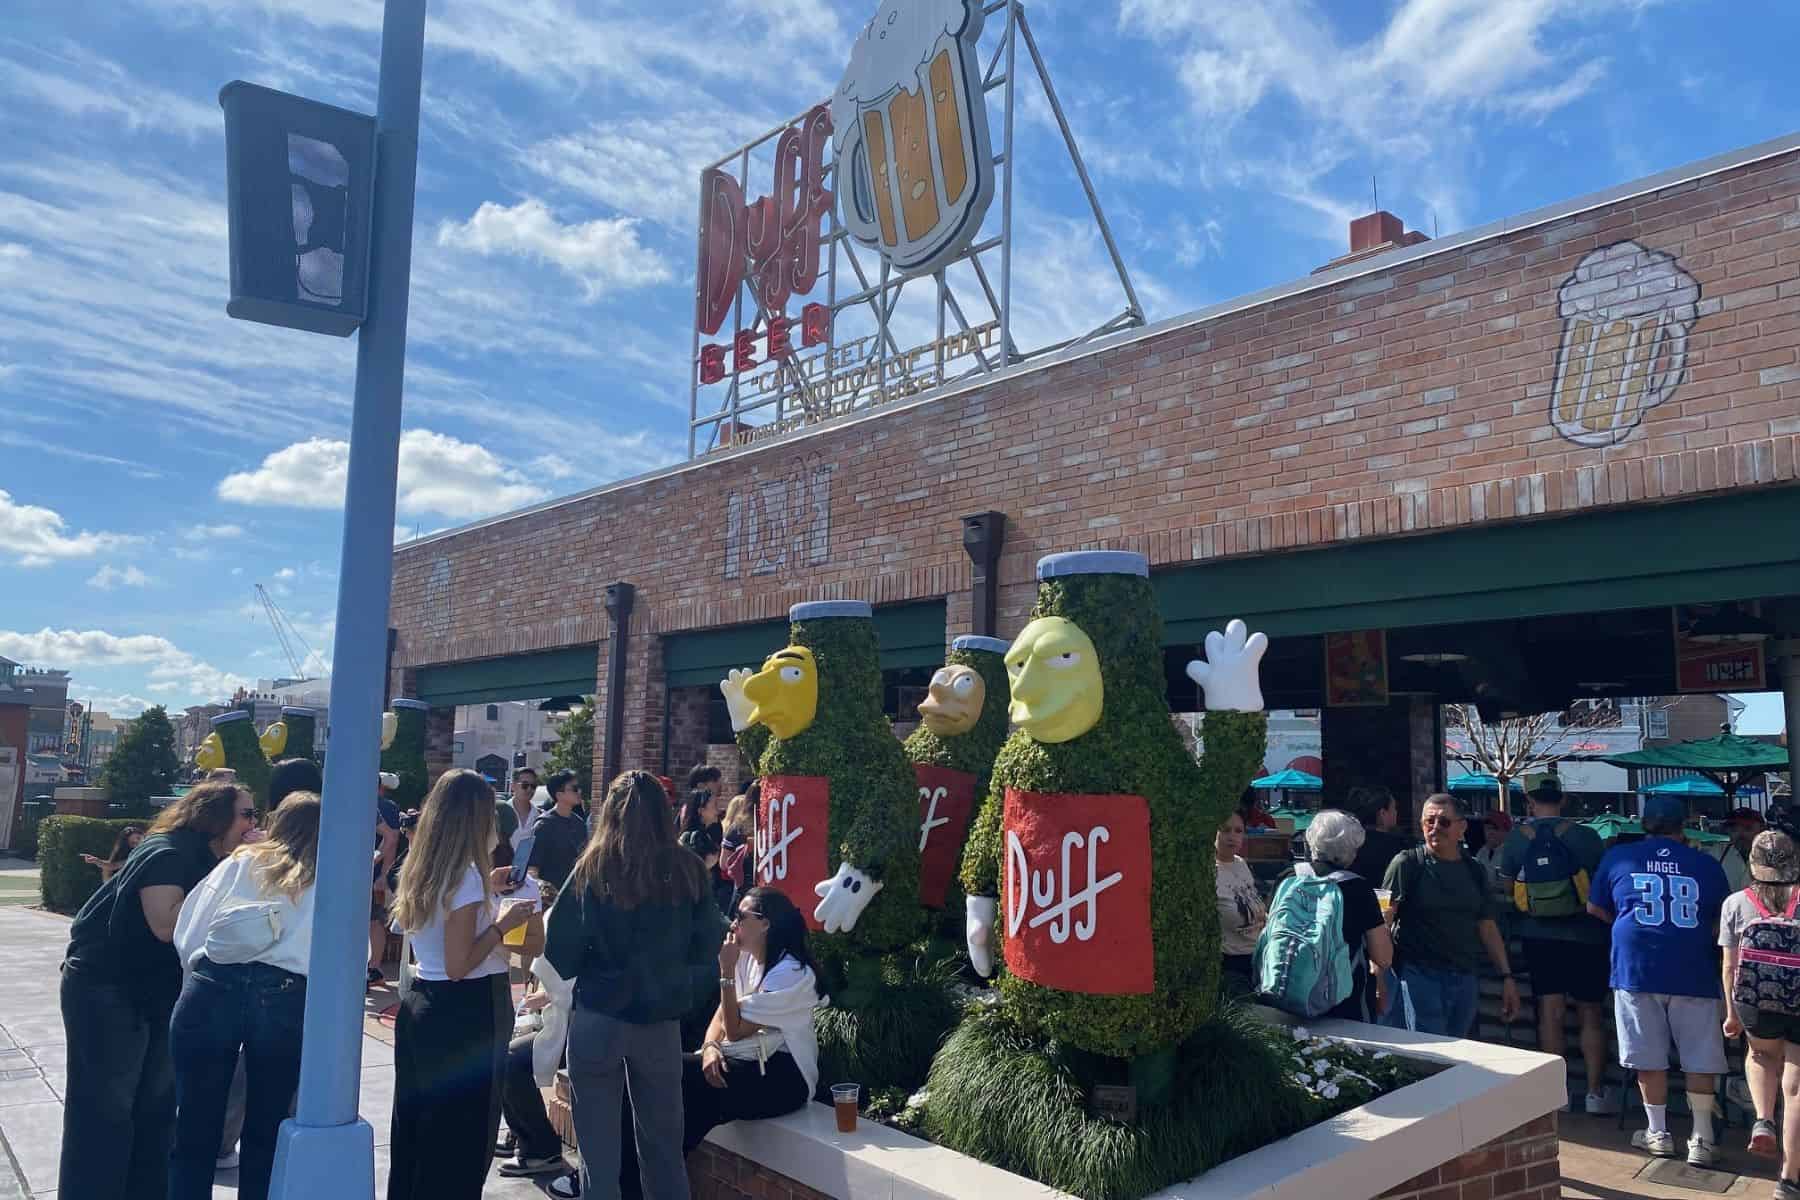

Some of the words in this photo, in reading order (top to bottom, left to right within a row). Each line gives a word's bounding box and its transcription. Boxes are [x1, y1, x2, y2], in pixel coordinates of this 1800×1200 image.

[697, 104, 834, 336] Duff
[700, 302, 830, 384] BEER
[824, 337, 867, 371] GET
[889, 344, 921, 379] OF
[932, 323, 996, 364] THAT
[1007, 826, 1123, 944] Duff
[1646, 860, 1681, 874] HAGEL
[1630, 872, 1700, 929] 38
